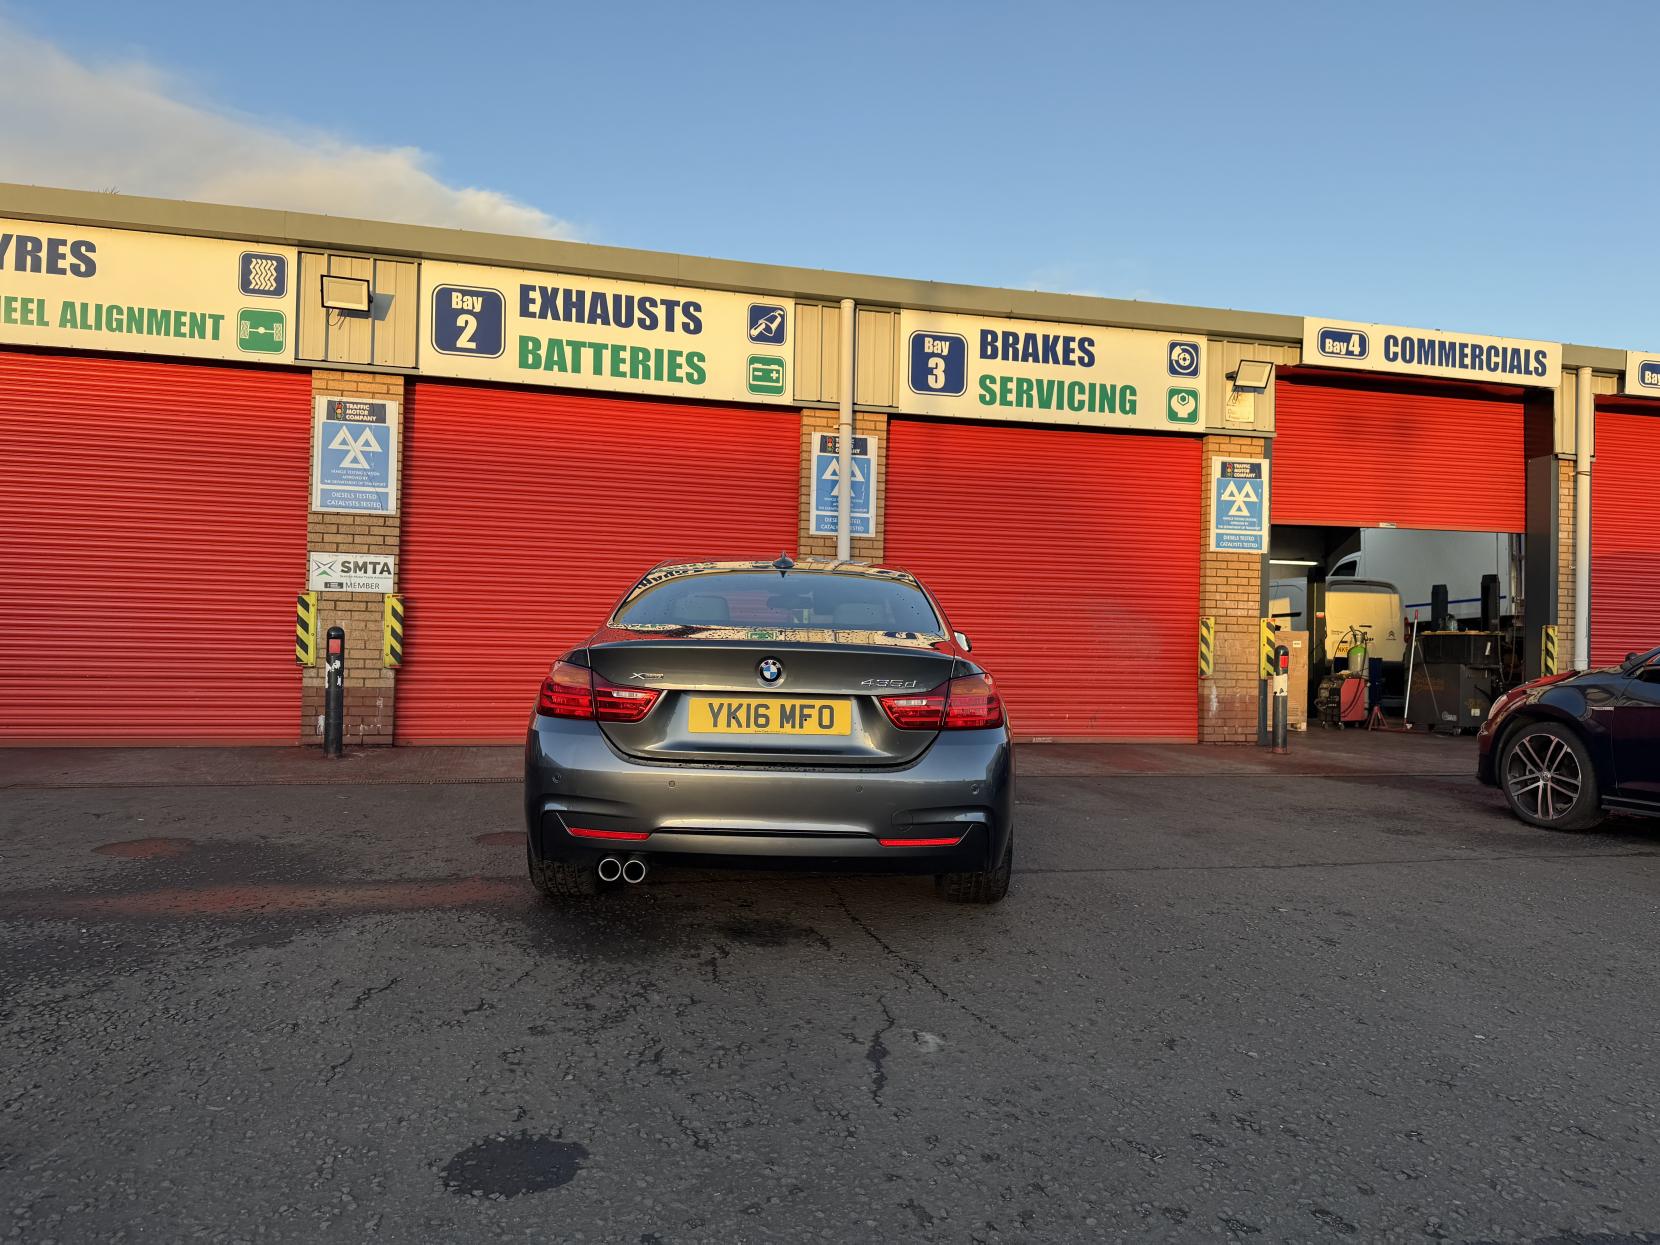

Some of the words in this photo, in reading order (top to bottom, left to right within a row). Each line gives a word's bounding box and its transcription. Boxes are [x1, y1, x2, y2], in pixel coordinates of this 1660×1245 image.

[451, 292, 483, 312] Bay
[519, 283, 702, 335] EXHAUSTS
[58, 300, 225, 341] ALIGNMENT
[456, 314, 477, 349] 2
[924, 337, 949, 355] Bay
[979, 329, 1095, 367] BRAKES
[1325, 338, 1347, 355] Bay
[1348, 334, 1360, 355] 4
[1384, 334, 1547, 377] COMMERCIALS
[518, 335, 706, 385] BATTERIES
[927, 357, 945, 389] 3
[1644, 370, 1660, 385] Ba
[978, 374, 1137, 415] SERVICING
[327, 499, 359, 507] CATALYSTS
[340, 561, 392, 575] SMTA
[345, 582, 380, 590] MEMBER
[861, 679, 917, 687] 435d
[708, 703, 770, 729] YK16
[780, 704, 834, 730] MFO
